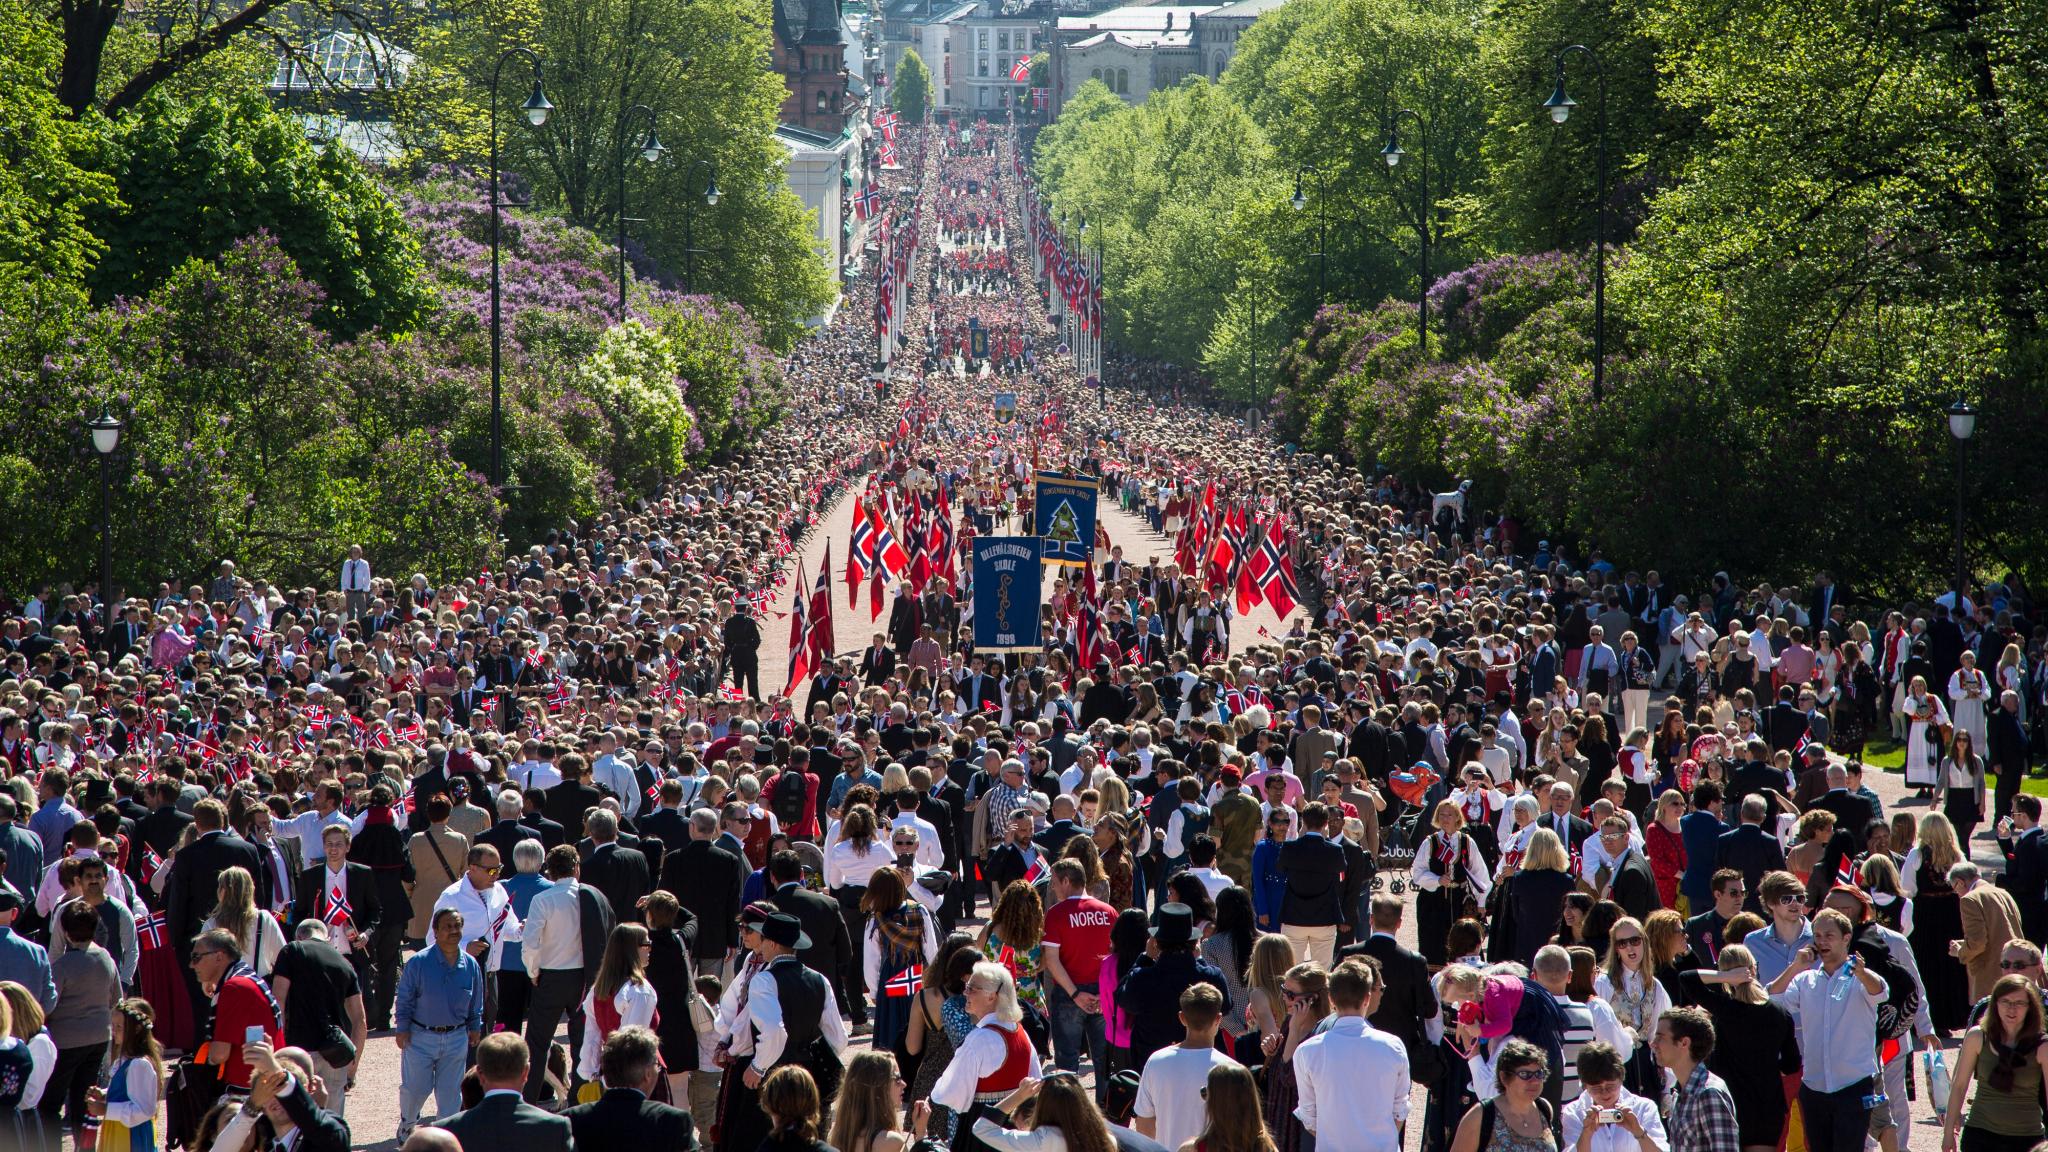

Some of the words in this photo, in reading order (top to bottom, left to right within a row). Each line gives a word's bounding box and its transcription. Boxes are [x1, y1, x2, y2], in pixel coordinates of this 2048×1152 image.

[993, 559, 1017, 571] SKOLE
[996, 633, 1016, 645] 1898
[1069, 911, 1111, 928] NORGE
